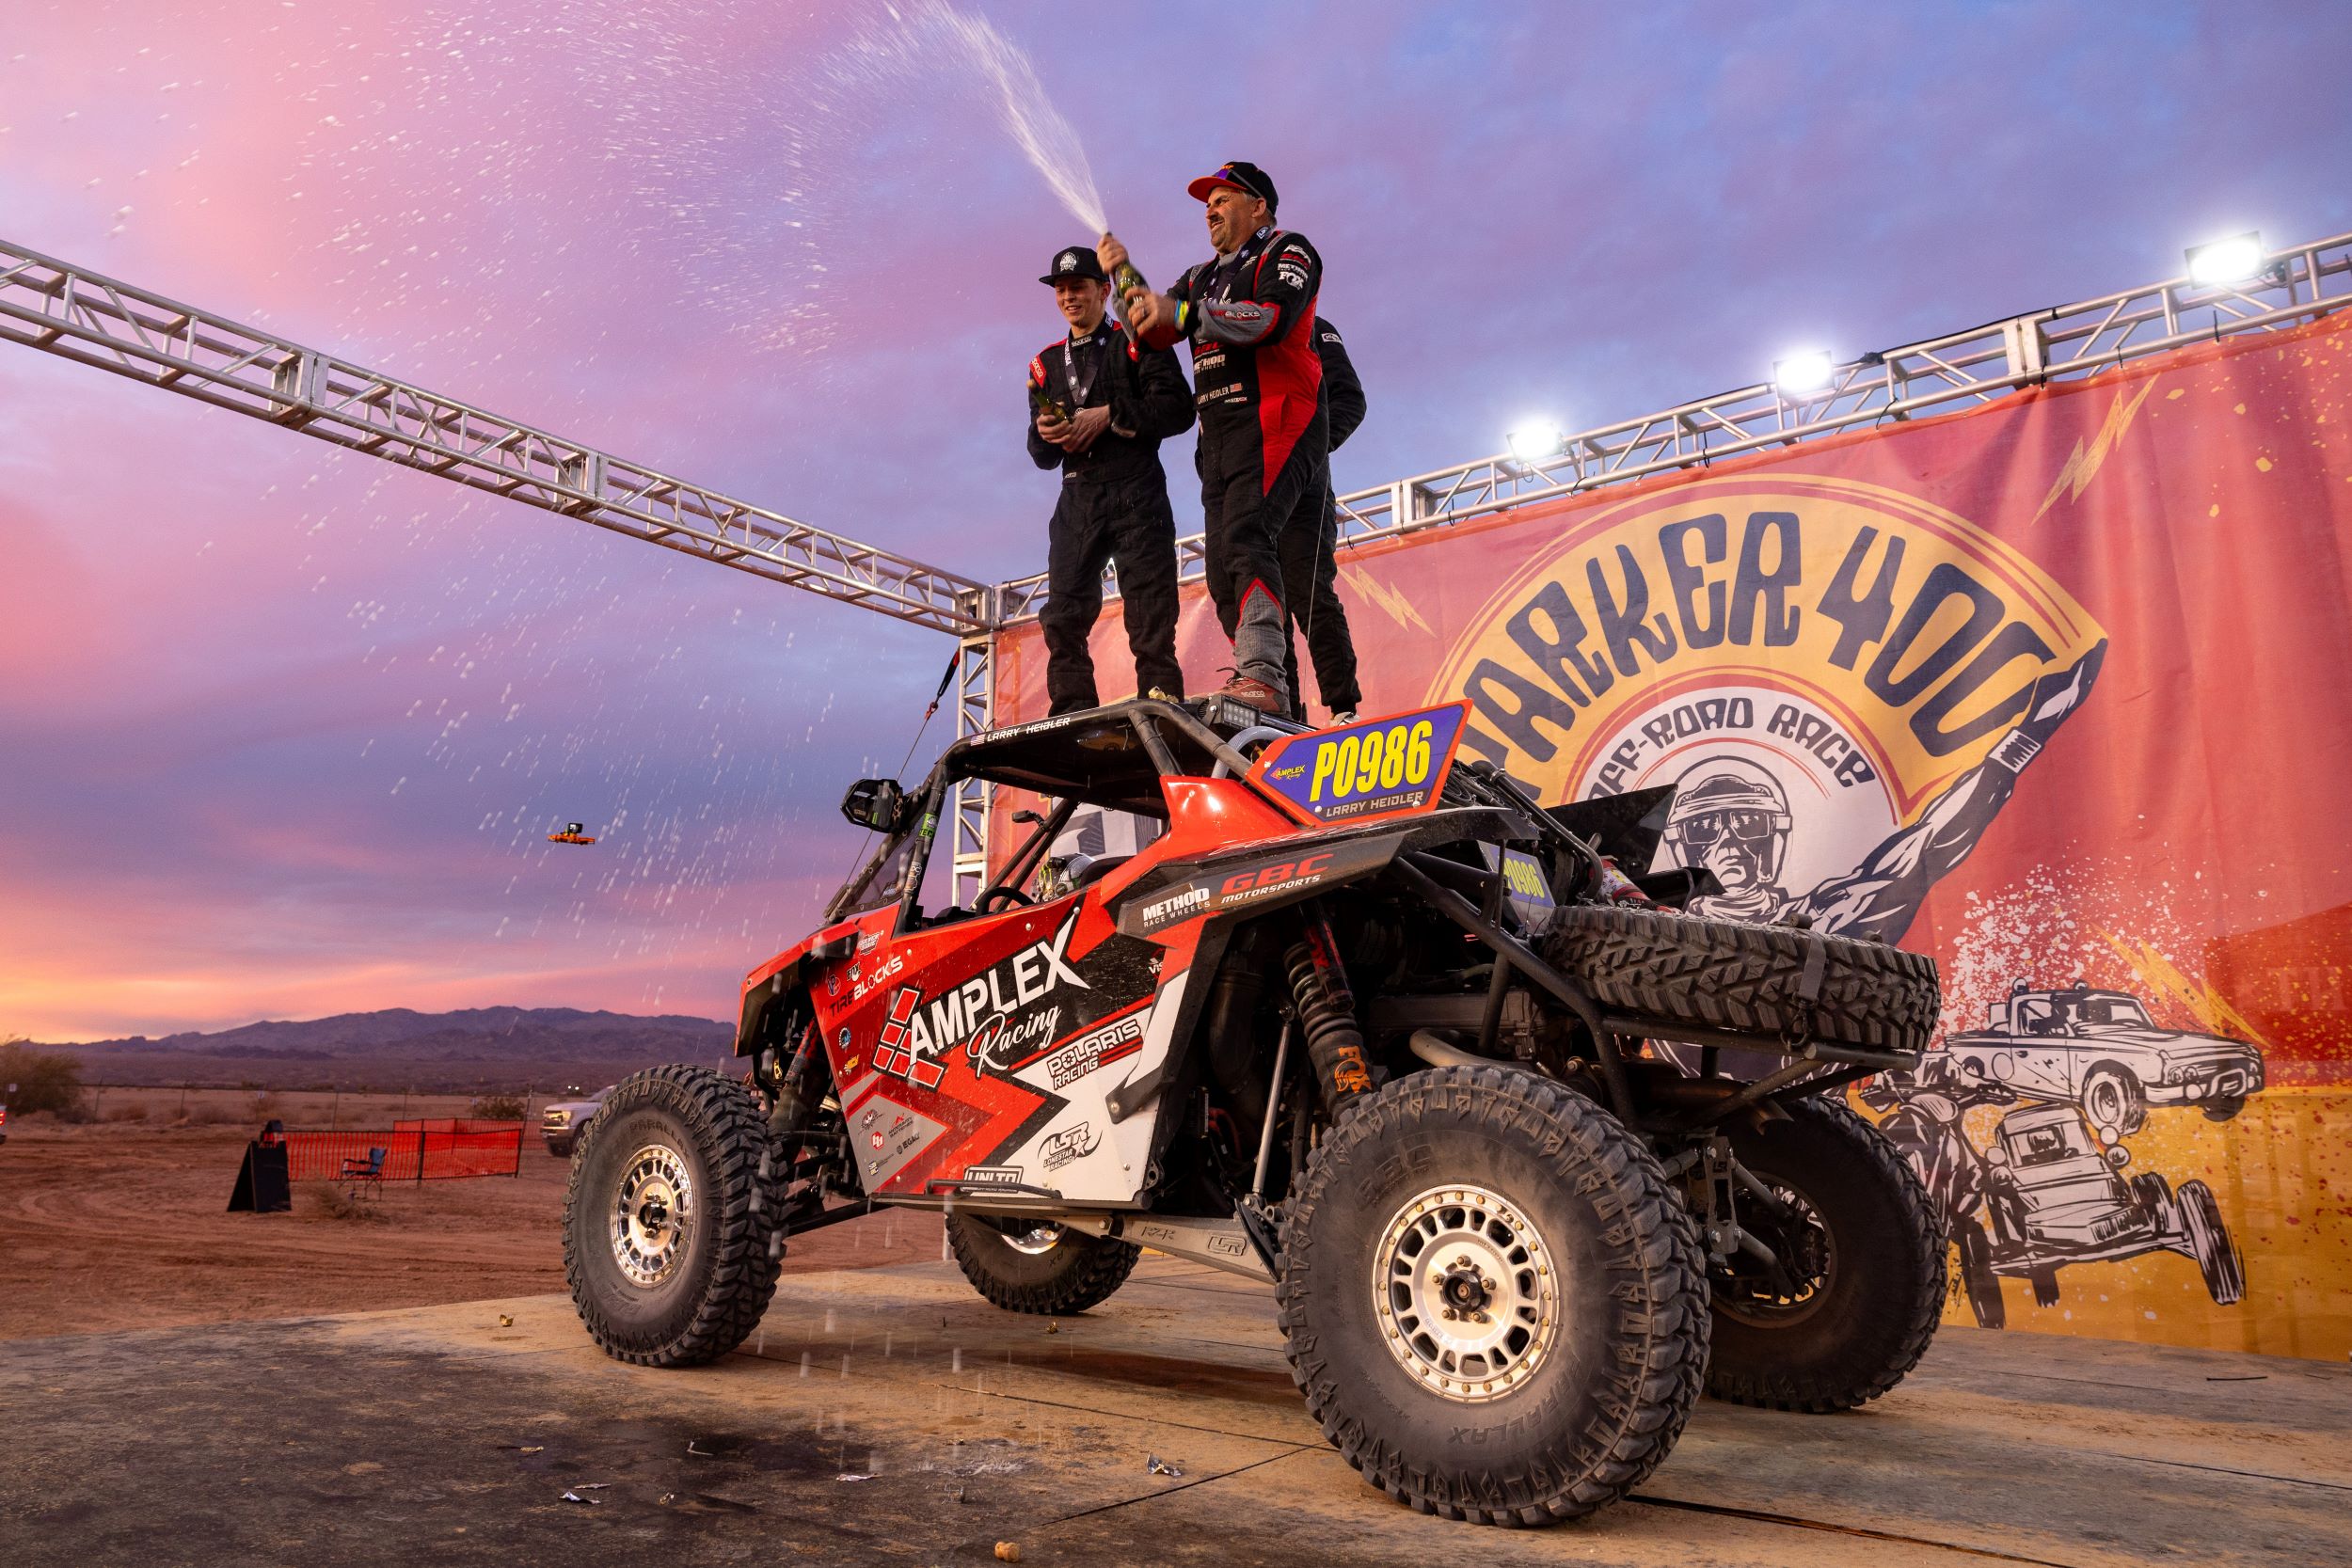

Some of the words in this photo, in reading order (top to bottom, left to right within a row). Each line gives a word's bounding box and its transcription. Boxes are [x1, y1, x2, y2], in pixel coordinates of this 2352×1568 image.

[1279, 271, 1304, 290] FOX
[1817, 526, 2058, 757] 400
[987, 727, 1021, 742] LARRY
[1025, 717, 1071, 735] HEIDLER
[1767, 704, 1876, 788] RACE
[1310, 720, 1433, 801] P0986
[1326, 801, 1366, 817] LARRY
[1370, 791, 1424, 810] HEIDLER
[1221, 853, 1334, 895] GBC
[1221, 875, 1321, 904] MOTORSPORTS
[1142, 887, 1210, 921] METHOD
[1143, 915, 1166, 927] RACE
[1169, 901, 1211, 919] WHEELS
[909, 913, 1091, 1066] AMPLEX
[967, 1006, 1061, 1078] Racing
[1047, 1019, 1141, 1078] POLARIS
[1053, 1054, 1100, 1091] RACING
[1049, 1121, 1089, 1156] LSR
[1043, 1148, 1073, 1168] LONESTAR
[1049, 1157, 1075, 1172] RACING
